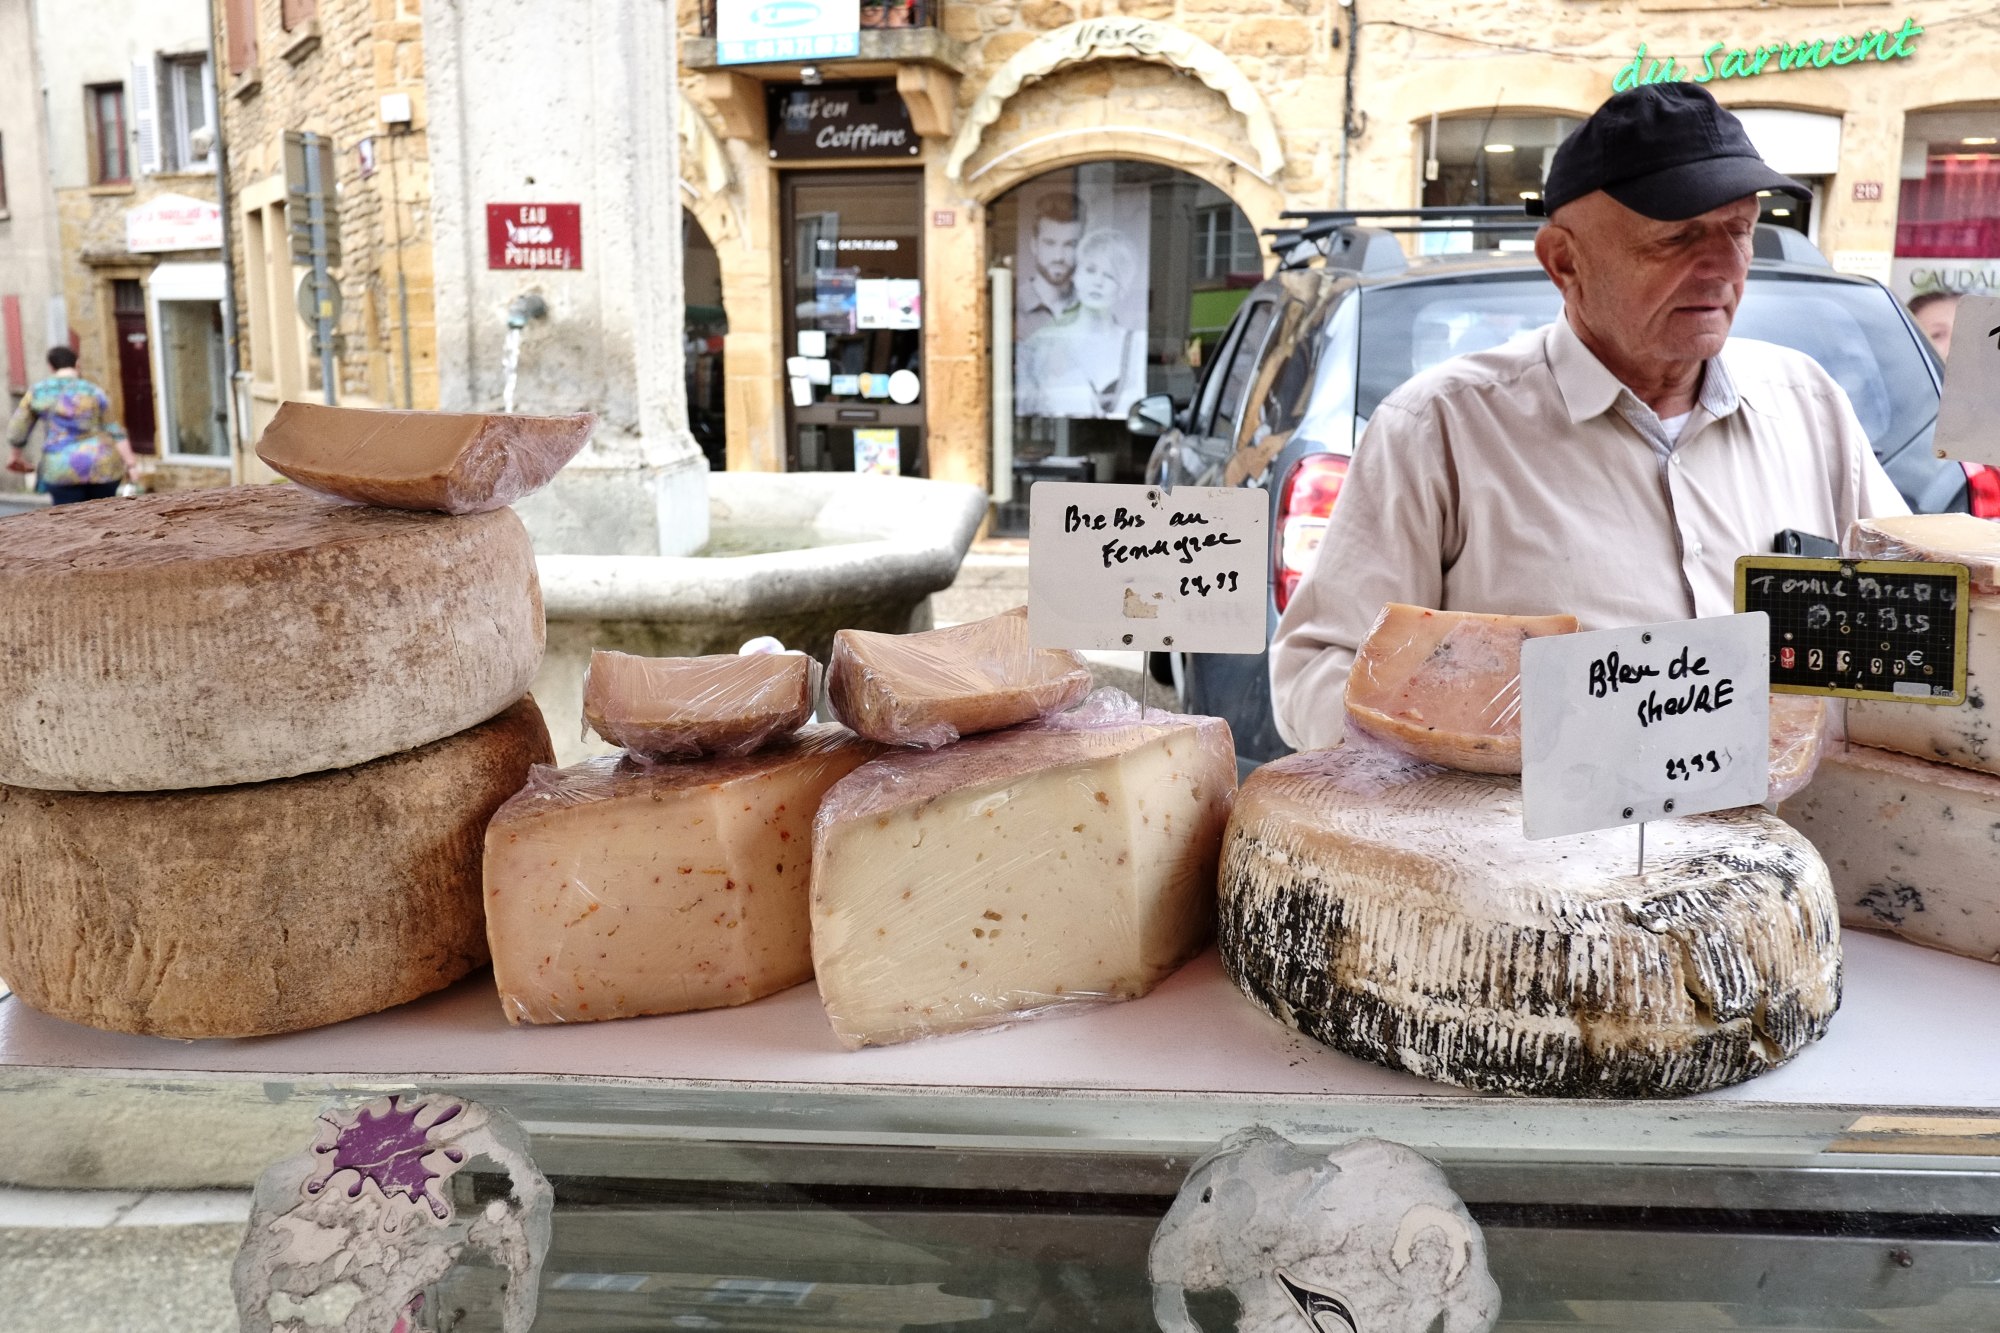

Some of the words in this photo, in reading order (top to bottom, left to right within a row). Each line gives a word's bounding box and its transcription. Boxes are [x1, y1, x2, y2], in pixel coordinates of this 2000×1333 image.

[1611, 42, 1687, 93] du
[816, 123, 907, 152] Coiffure
[519, 206, 547, 225] EAU
[504, 247, 563, 266] POTABLE
[1168, 511, 1210, 527] au
[1667, 645, 1710, 680] de
